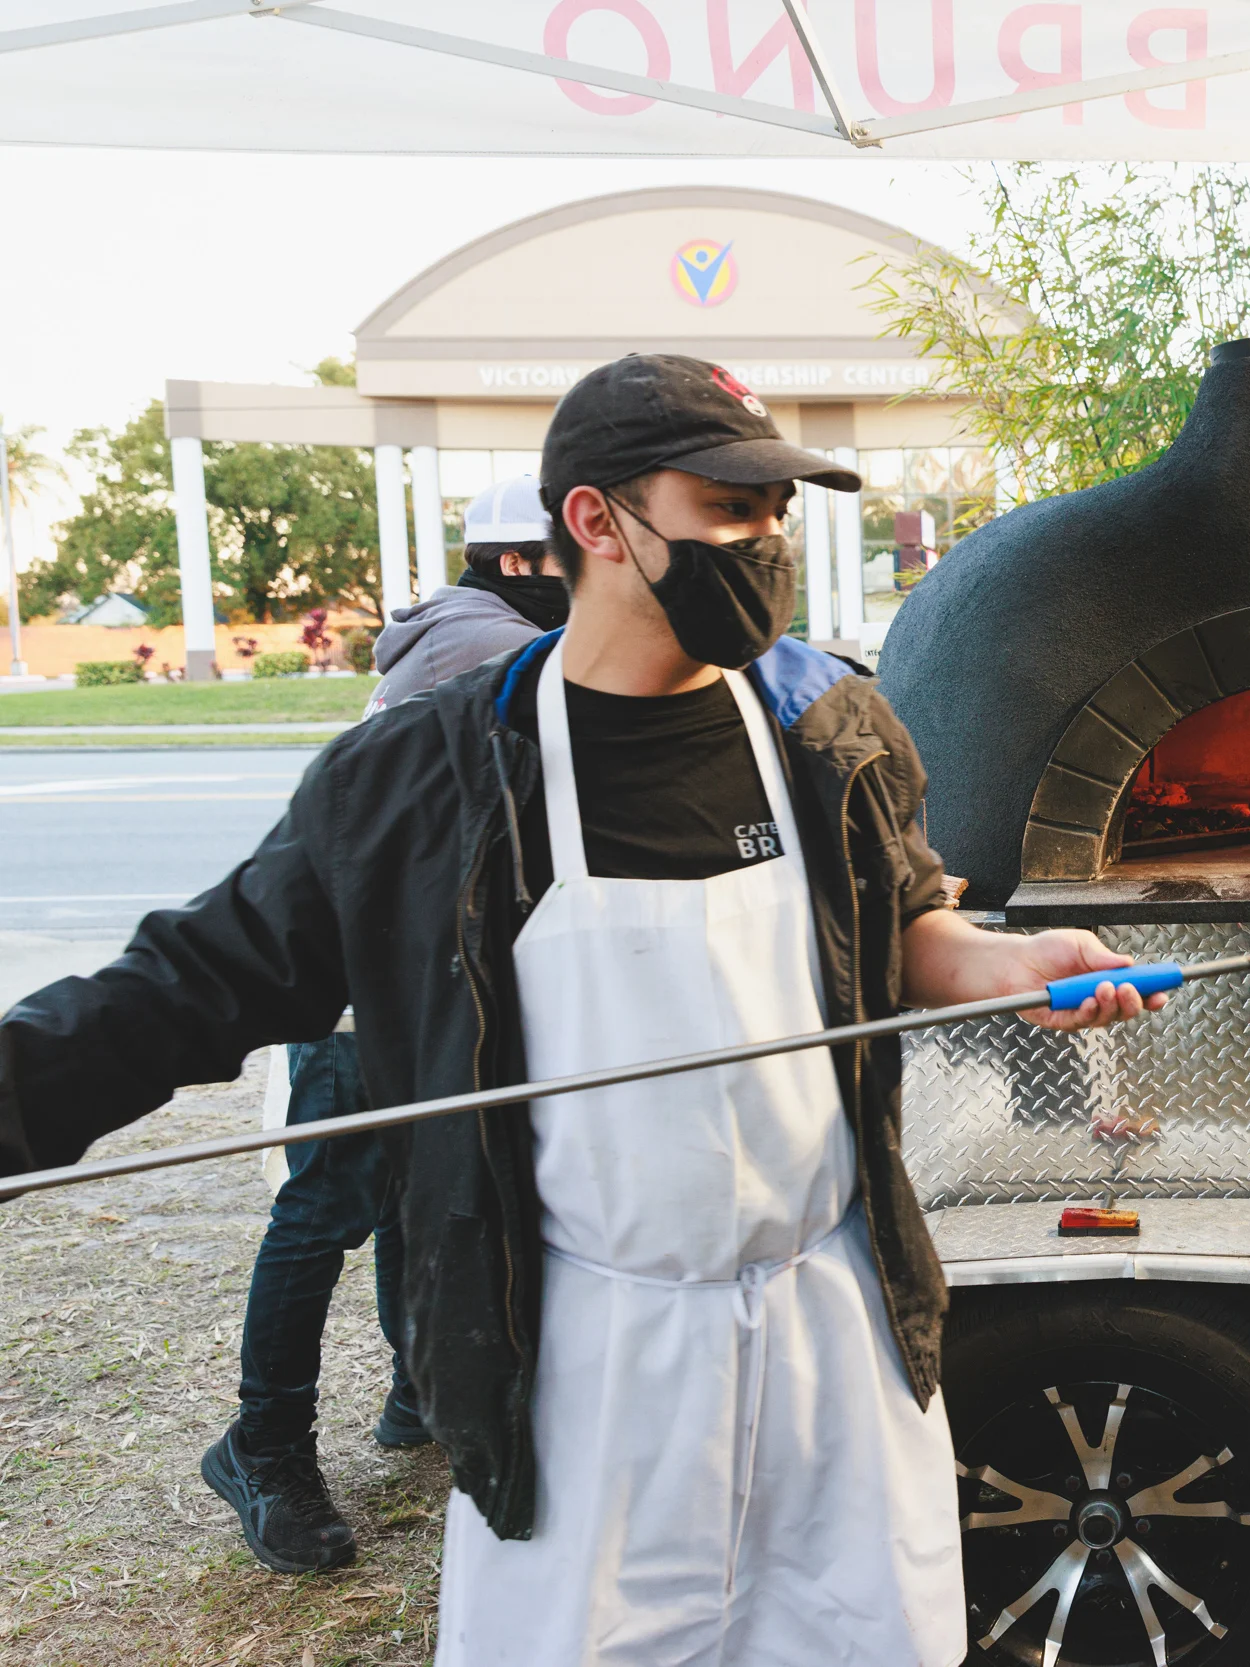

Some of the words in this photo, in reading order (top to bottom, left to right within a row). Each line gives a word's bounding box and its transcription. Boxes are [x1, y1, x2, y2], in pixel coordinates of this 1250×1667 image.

[480, 366, 580, 386] VICTORY
[731, 365, 831, 386] DERSHIP
[842, 366, 929, 386] CENTER
[737, 836, 778, 859] BR
